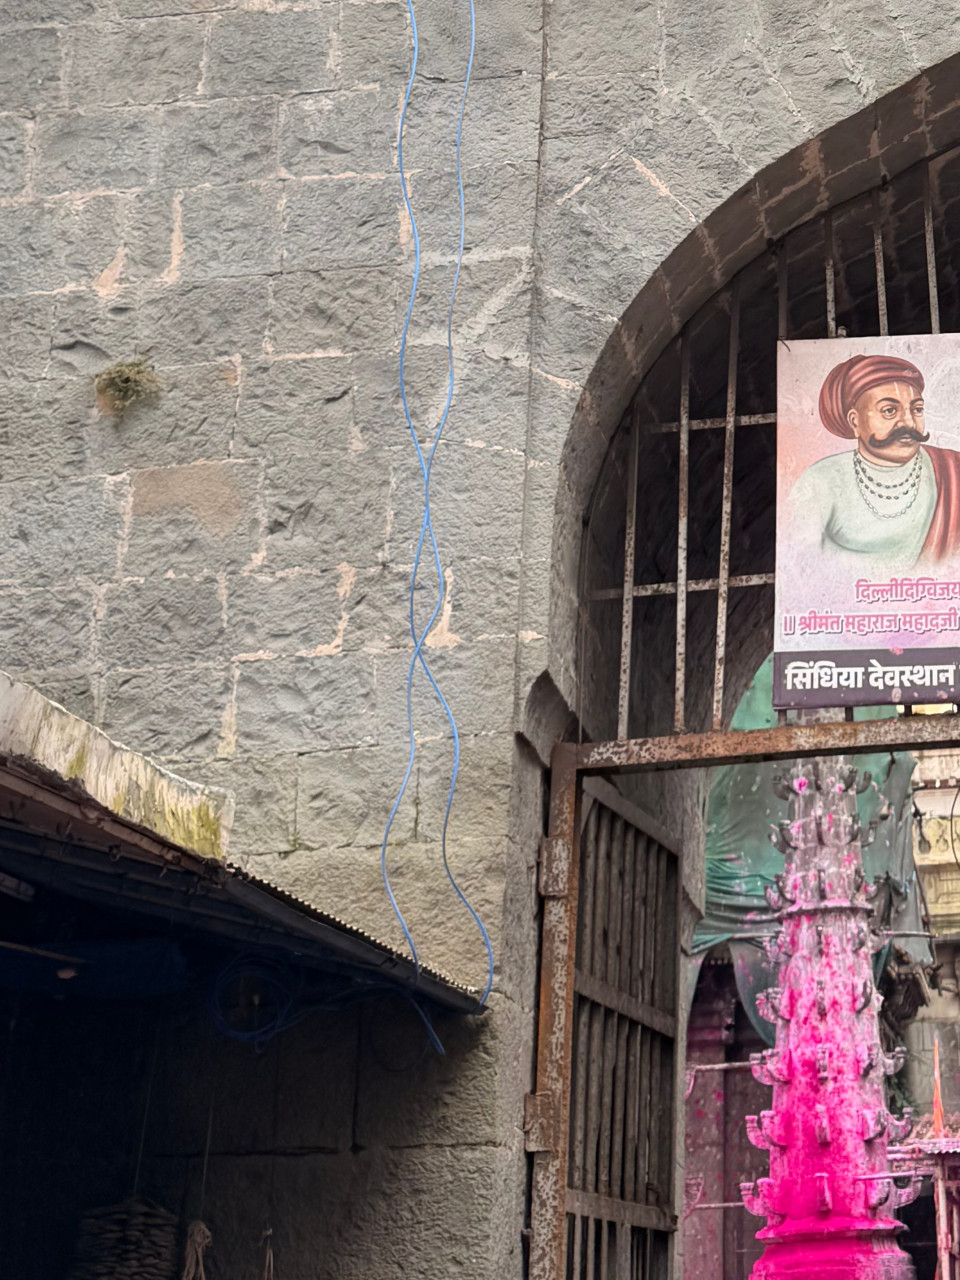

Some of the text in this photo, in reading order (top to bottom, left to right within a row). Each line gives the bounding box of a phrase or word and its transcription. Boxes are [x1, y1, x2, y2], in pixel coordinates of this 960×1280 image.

[798, 609, 842, 634] श्रीमंत
[843, 612, 900, 634] महाराज
[900, 607, 960, 633] महादजी
[785, 661, 864, 689] सिंधिया
[868, 659, 955, 690] देवस्थान
